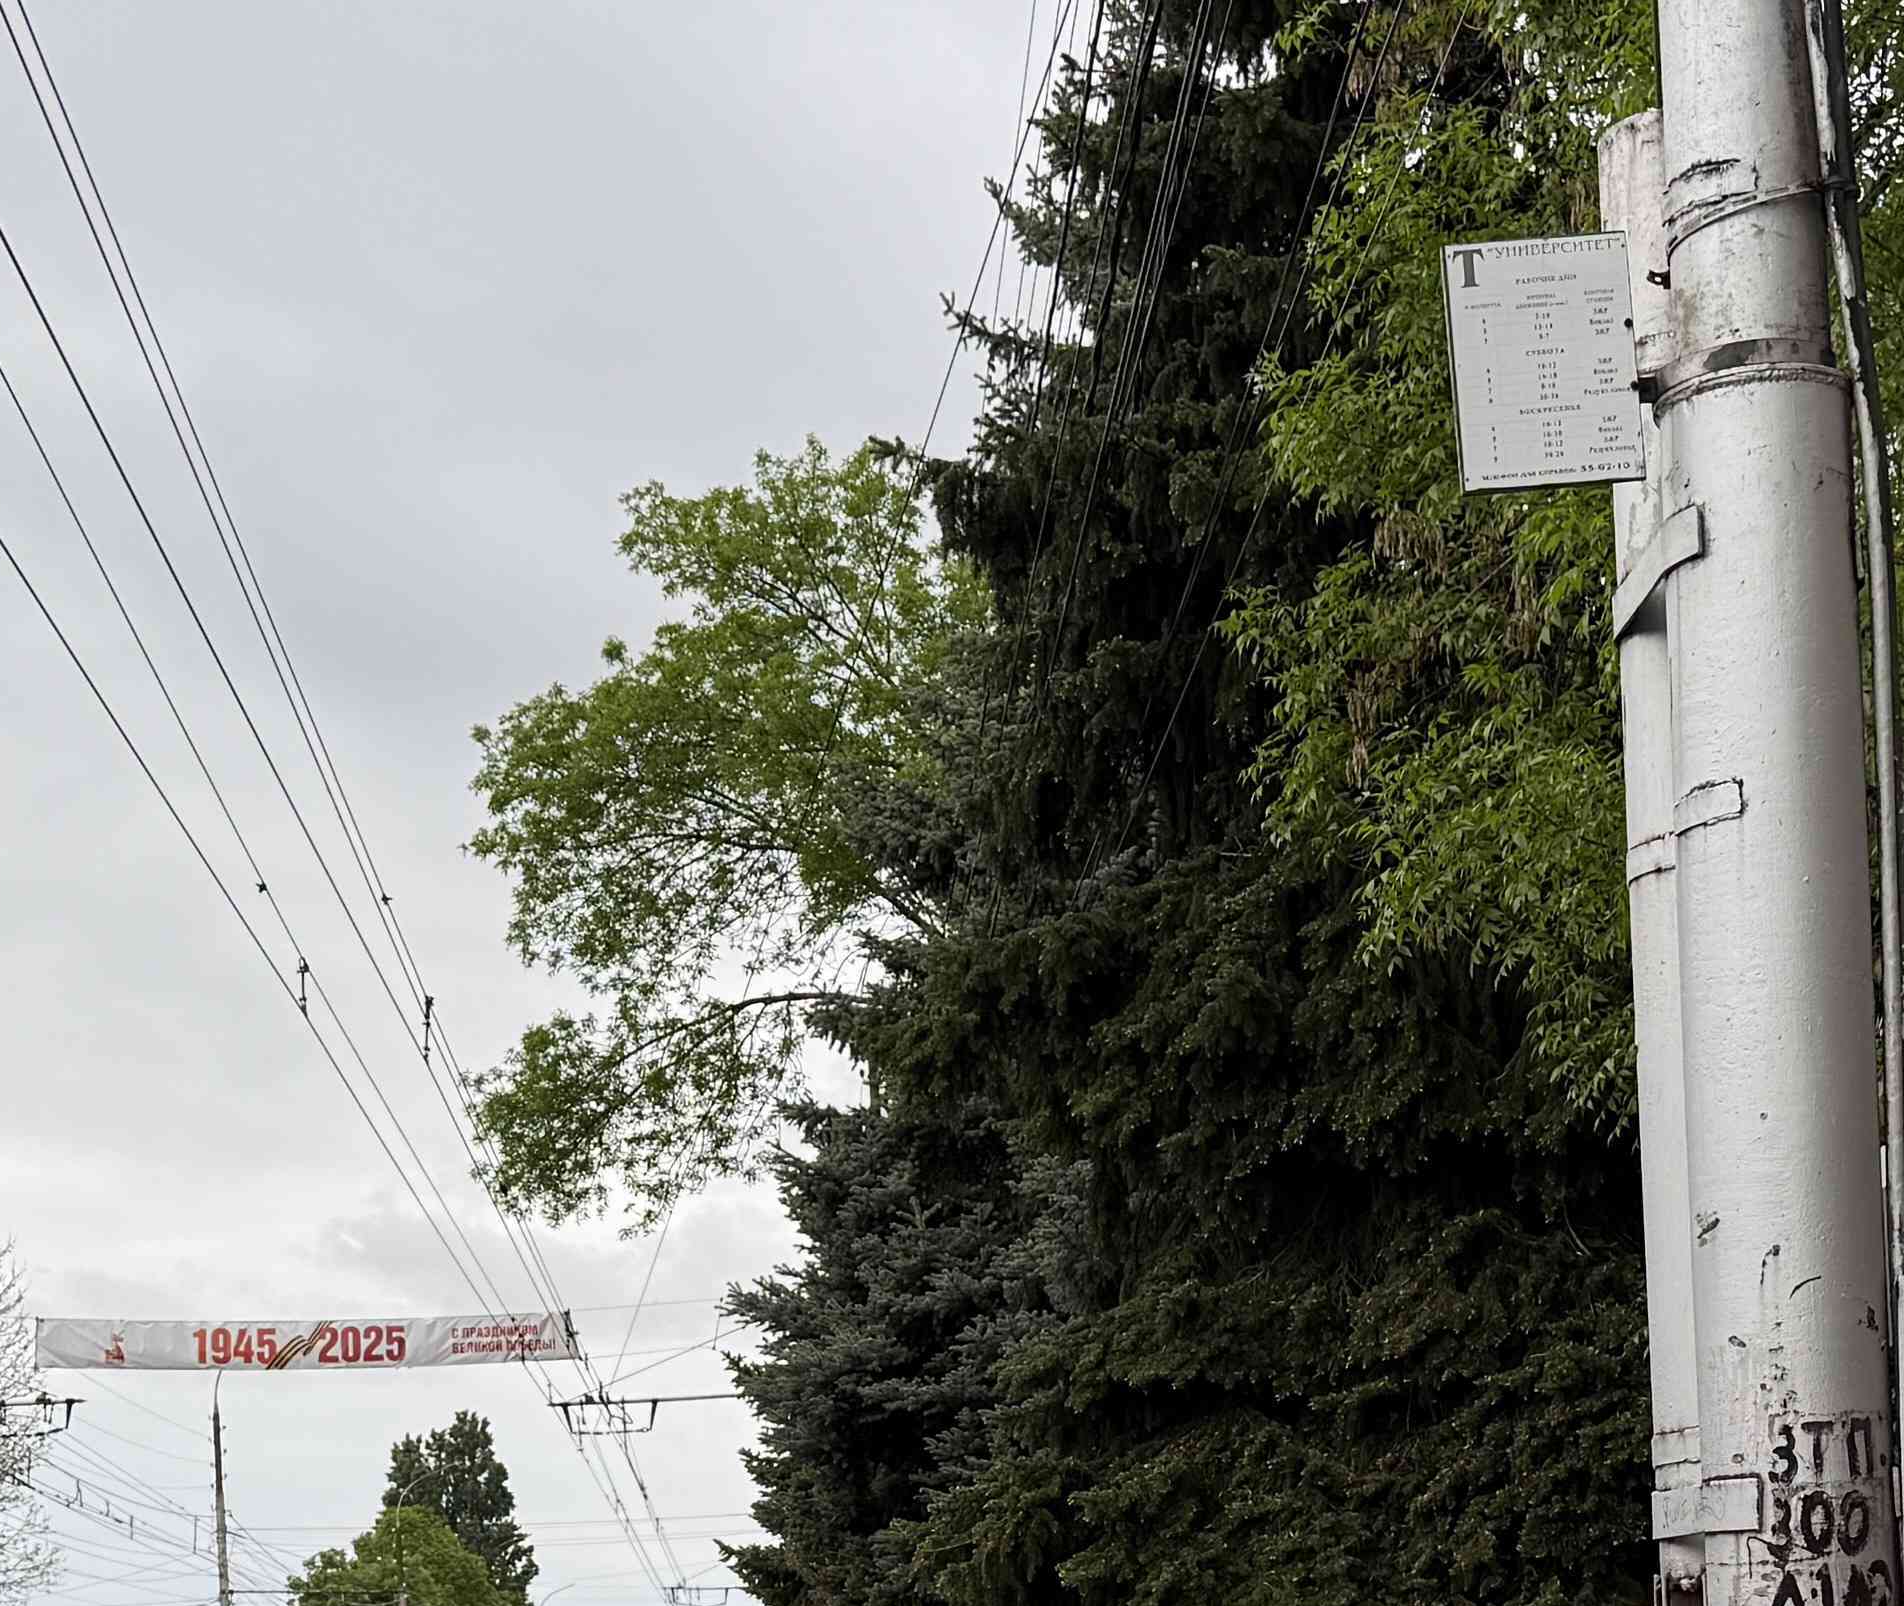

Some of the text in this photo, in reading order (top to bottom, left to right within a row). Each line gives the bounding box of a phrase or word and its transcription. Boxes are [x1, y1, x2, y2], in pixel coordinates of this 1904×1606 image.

[1452, 248, 1485, 289] Т
[192, 1327, 277, 1365] 1945
[319, 1325, 406, 1364] 2025
[451, 1328, 459, 1339] С
[452, 1340, 503, 1354] ВЕЛИКОЙ
